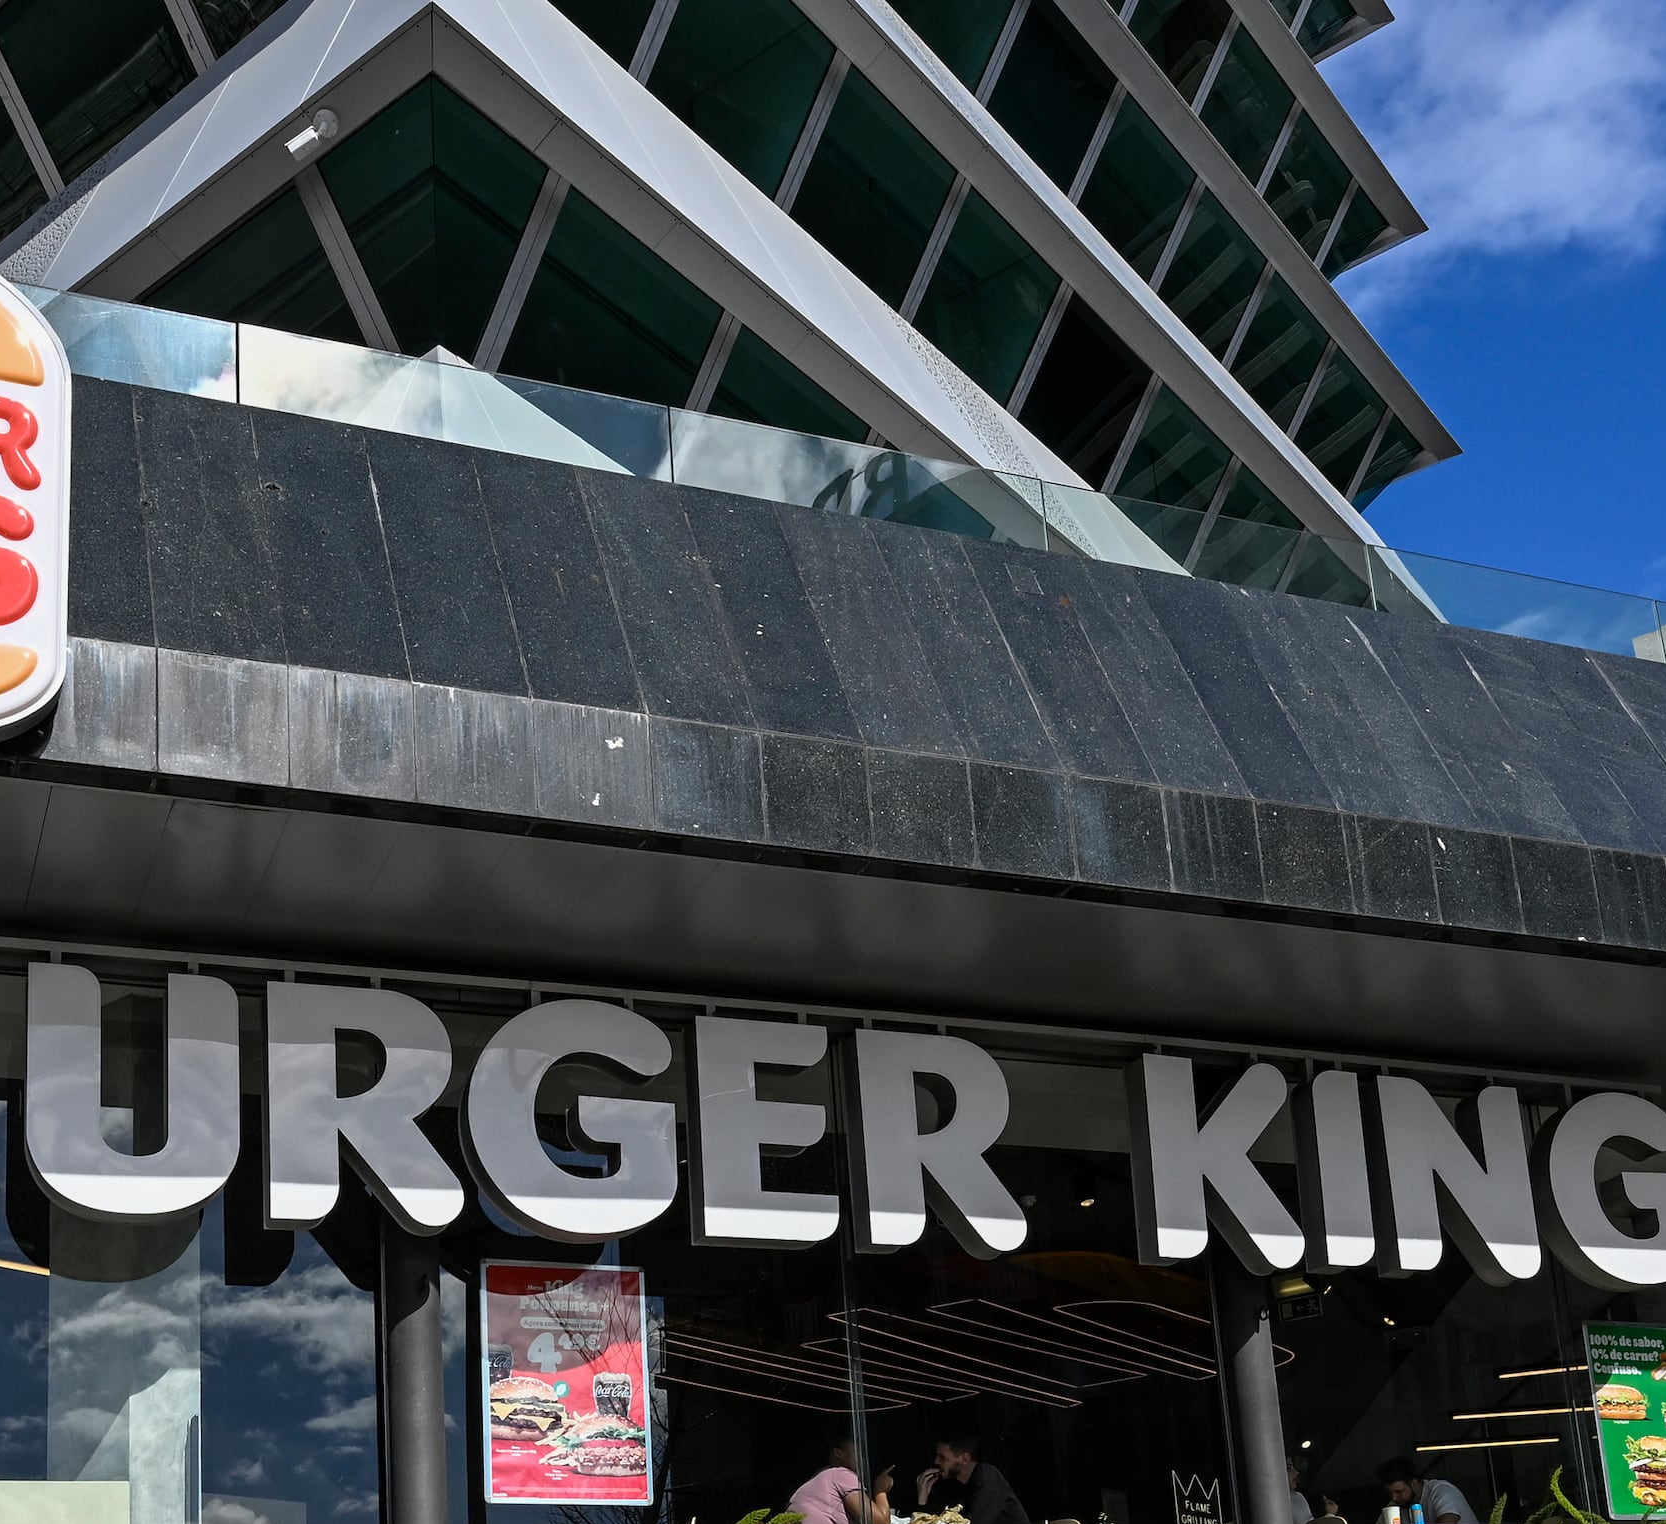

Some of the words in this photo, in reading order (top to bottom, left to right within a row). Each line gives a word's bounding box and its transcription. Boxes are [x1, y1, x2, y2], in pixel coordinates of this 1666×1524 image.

[545, 1279, 585, 1299] King
[1589, 1334, 1618, 1346] 100%
[1619, 1335, 1632, 1347] de
[1632, 1336, 1665, 1350] sabor,
[1591, 1348, 1609, 1360] 0%
[1610, 1348, 1622, 1360] de
[1623, 1350, 1660, 1362] carne?
[1594, 1362, 1642, 1376] Confuso.
[1184, 1499, 1212, 1514] FLAME
